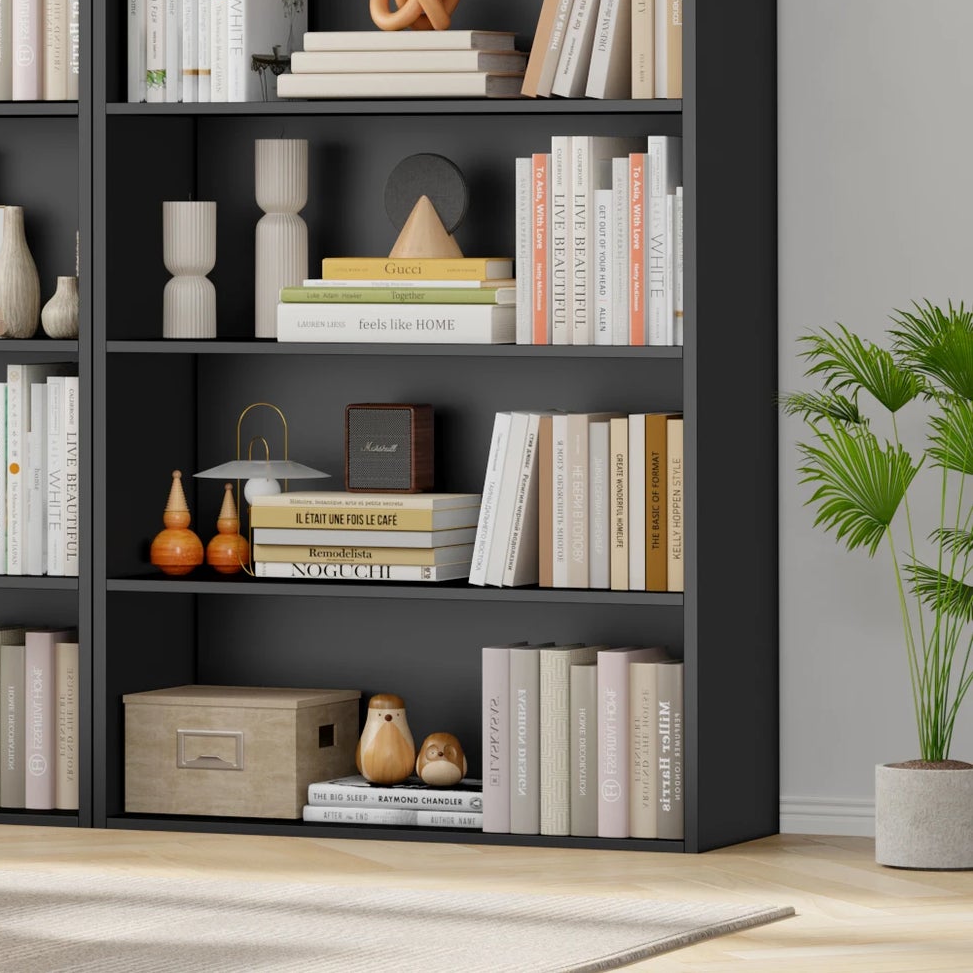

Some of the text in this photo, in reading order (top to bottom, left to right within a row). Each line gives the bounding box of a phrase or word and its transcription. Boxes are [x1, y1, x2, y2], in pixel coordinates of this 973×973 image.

[555, 21, 564, 31] IS
[558, 13, 566, 21] A
[572, 17, 582, 31] for
[550, 31, 562, 52] THIS
[383, 262, 422, 275] Gucci
[553, 194, 566, 330] LIVE BEAUTIFUL
[573, 194, 586, 330] LIVE BEAUTIFUL
[598, 204, 606, 332] GET OUT OF YOUR HEAD ALLEN
[650, 233, 664, 299] WHITE
[390, 290, 426, 301] Together
[358, 318, 456, 331] feels like HOME
[615, 453, 624, 478] CREATE
[48, 469, 62, 531] WHITE
[66, 432, 78, 562] LIVE BEAUTIFUL
[615, 478, 624, 517] WONDERFUL
[650, 450, 660, 551] THE BASIC OF FORMAT
[295, 508, 398, 527] IL ÉTAIT UNE FOIS LE CAFÉ
[672, 458, 682, 560] KELLY HOPPEN STYLE
[308, 547, 373, 560] Remodelista
[291, 562, 391, 580] NOGUCHI
[313, 792, 464, 807] THE BIG SLEEP RAYMOND CHANDLER
[430, 816, 476, 826] AUTHOR NAME
